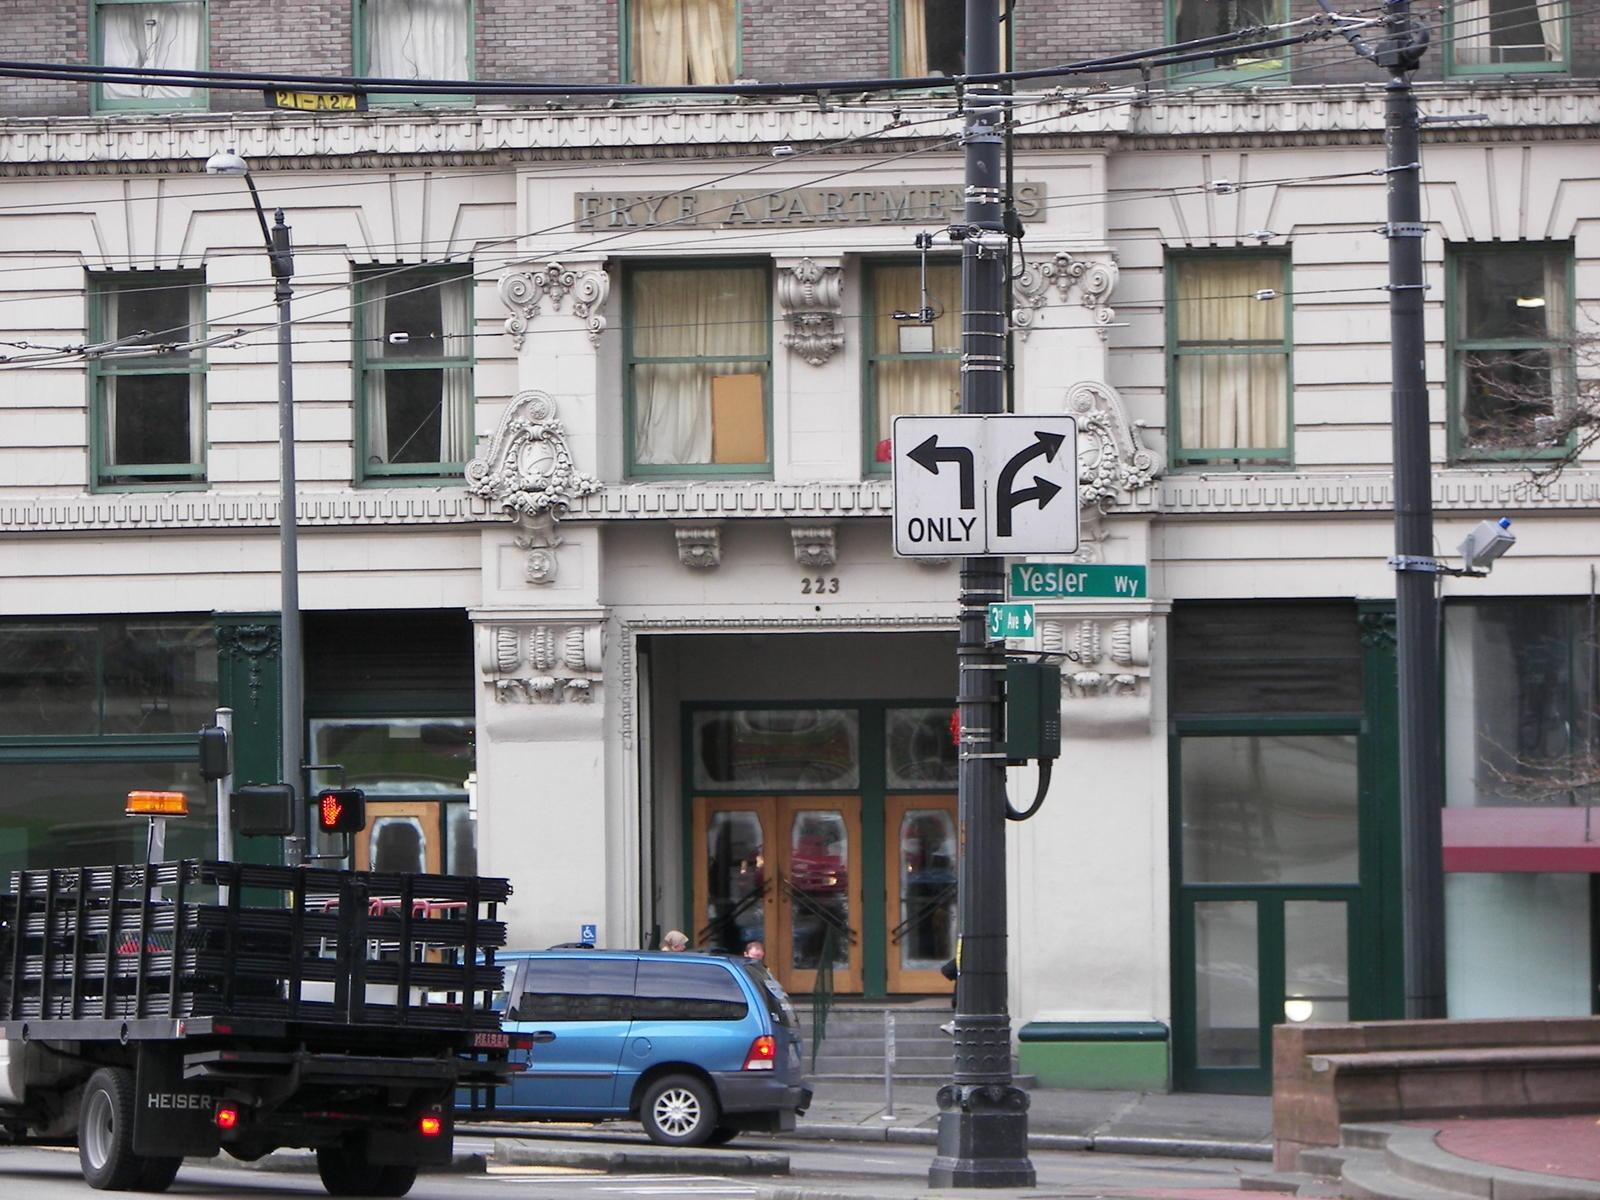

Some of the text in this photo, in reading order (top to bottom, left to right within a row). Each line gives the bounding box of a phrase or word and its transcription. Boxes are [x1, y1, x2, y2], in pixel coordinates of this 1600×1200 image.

[578, 185, 1039, 228] FRYE APARTMES
[908, 517, 977, 542] ONLY
[801, 577, 840, 594] 223
[1019, 566, 1138, 597] Yesler Wy
[1007, 611, 1020, 630] Ave
[474, 1032, 510, 1048] HEISER
[148, 1093, 212, 1109] HEISER
